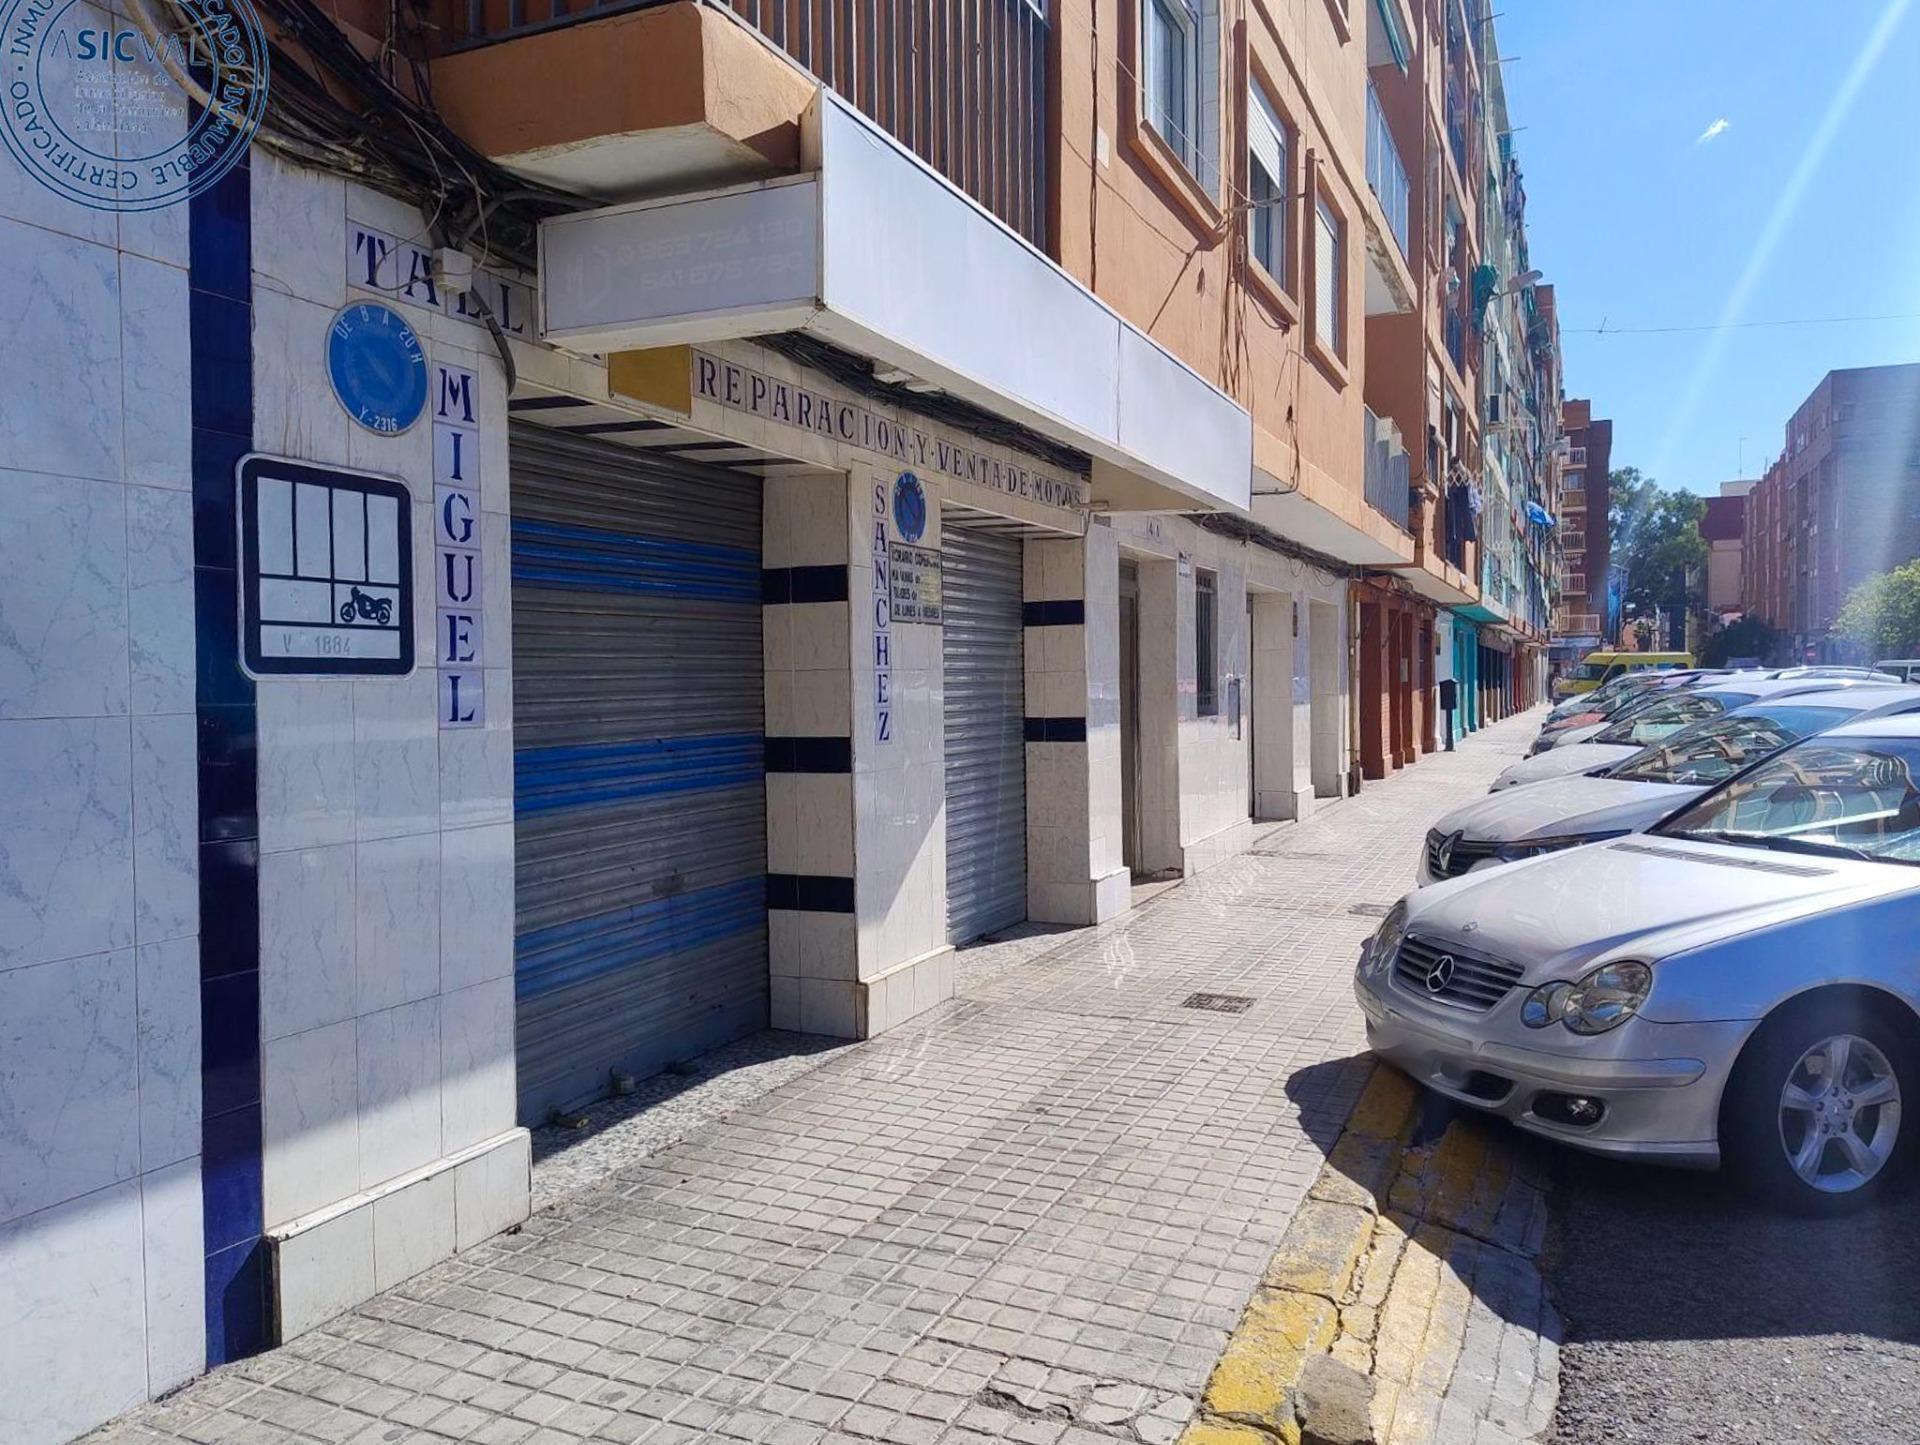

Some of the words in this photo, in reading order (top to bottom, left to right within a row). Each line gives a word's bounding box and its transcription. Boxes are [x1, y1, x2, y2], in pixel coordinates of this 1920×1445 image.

[382, 310, 390, 327] A
[399, 326, 416, 349] 20
[699, 357, 907, 458] REPARACION
[437, 367, 476, 722] MIGUEL
[873, 484, 890, 741] SANCHEZ
